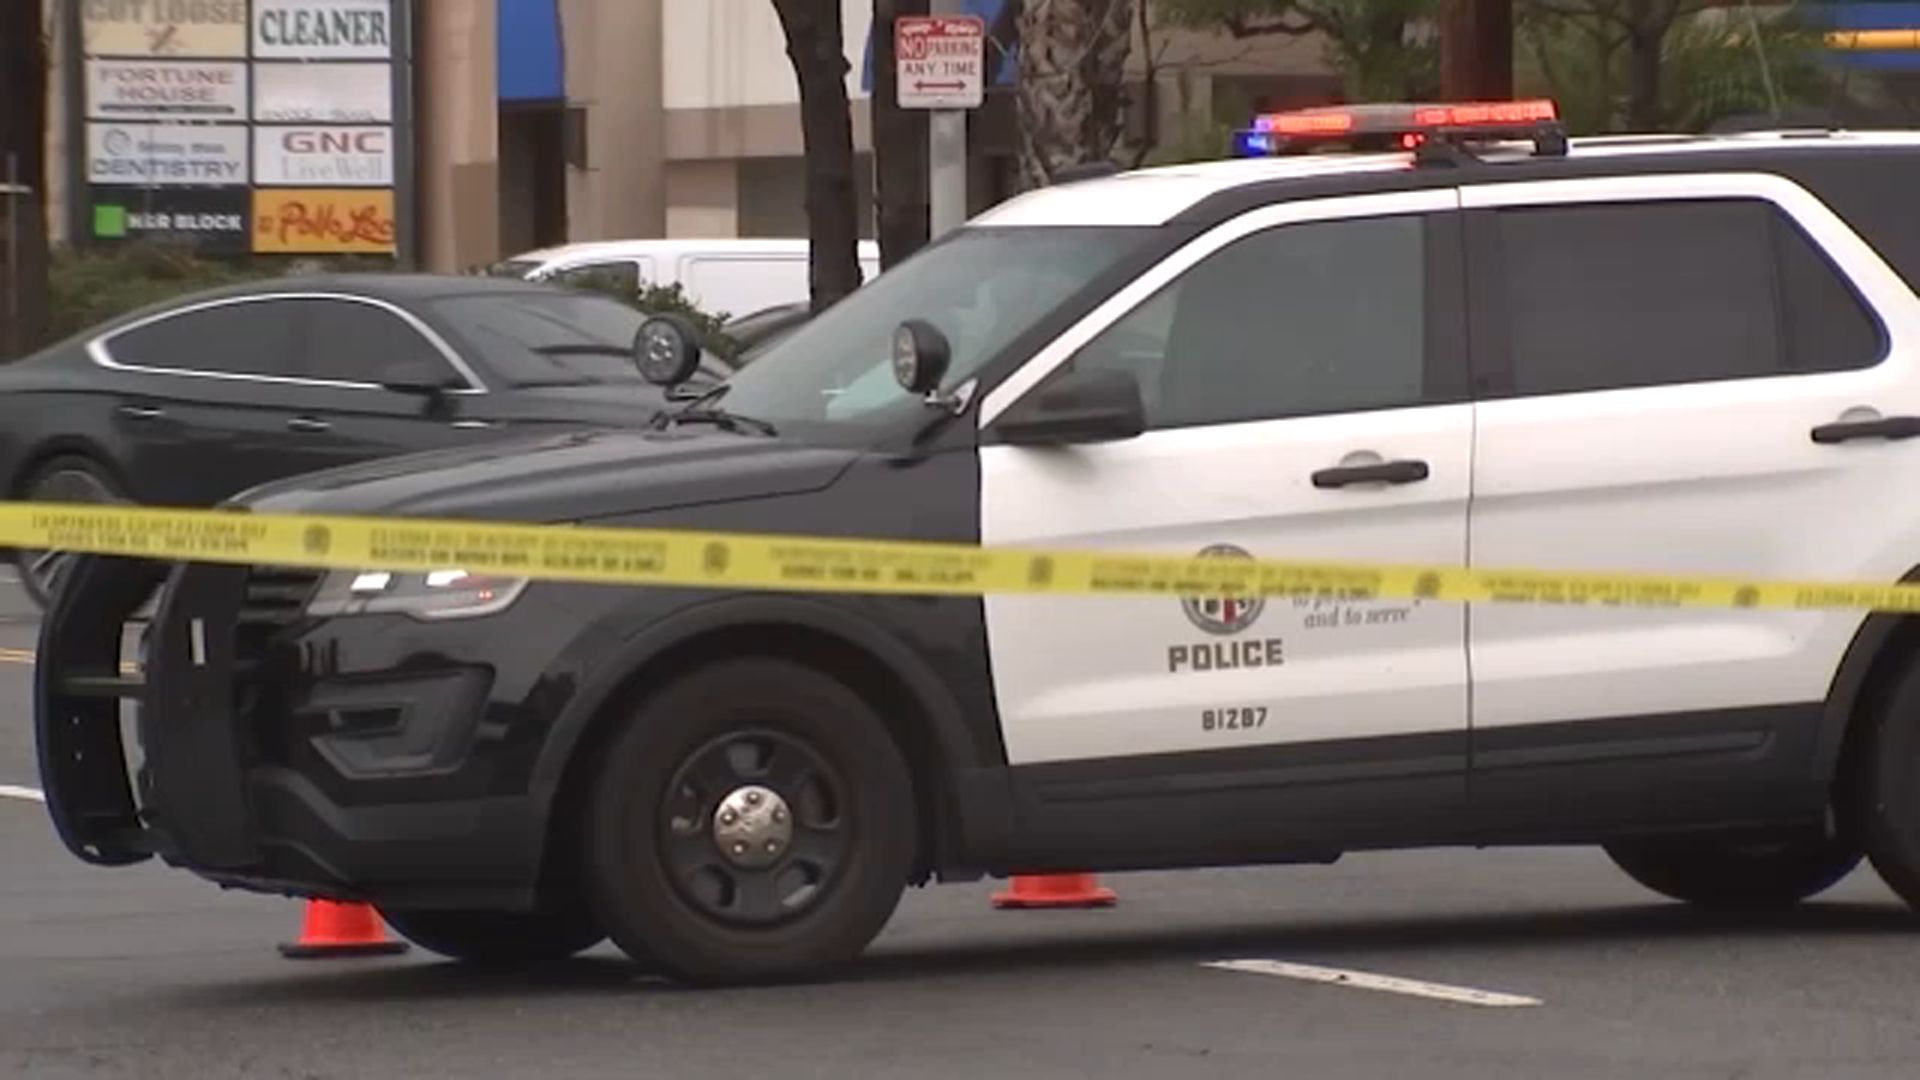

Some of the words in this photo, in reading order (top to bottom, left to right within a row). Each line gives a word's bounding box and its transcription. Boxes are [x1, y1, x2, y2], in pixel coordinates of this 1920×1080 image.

[260, 9, 388, 47] CLEANER
[900, 35, 926, 59] NO
[927, 40, 979, 57] PARKING
[100, 67, 235, 85] FORTUNE
[904, 61, 937, 76] ANY
[943, 61, 977, 76] TIME
[116, 86, 217, 102] HOUSE
[282, 131, 385, 154] GNC
[93, 158, 240, 178] DENTISTRY
[174, 213, 242, 230] BLOCK
[1303, 605, 1340, 630] and
[1343, 605, 1363, 626] to
[1167, 638, 1285, 673] POLICE
